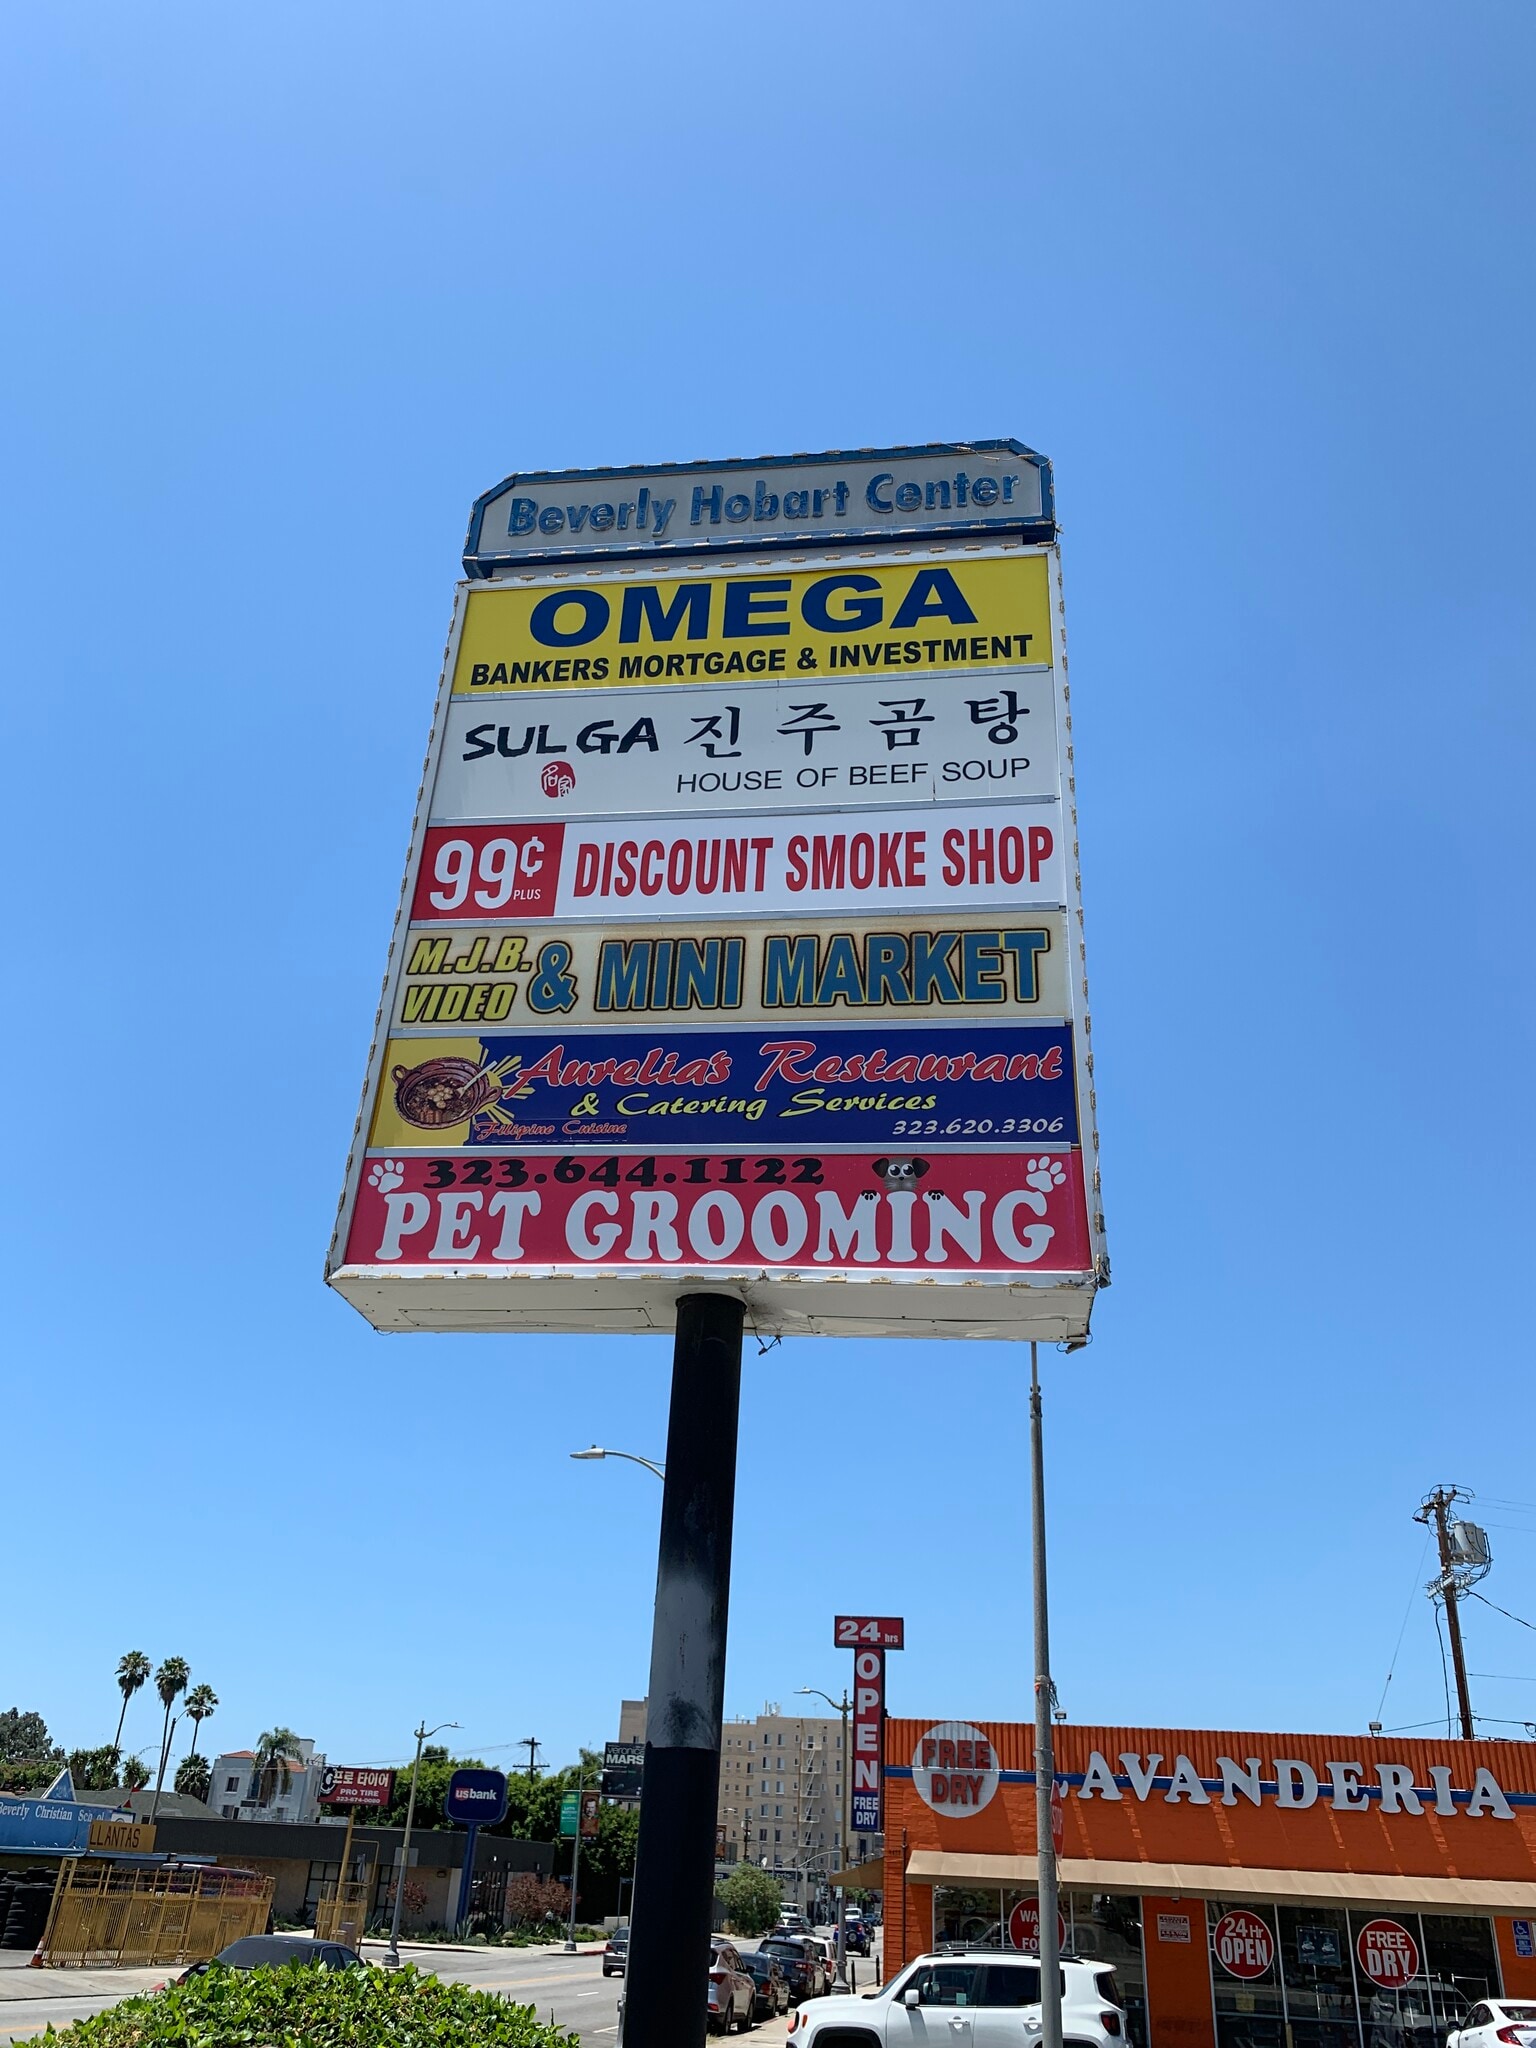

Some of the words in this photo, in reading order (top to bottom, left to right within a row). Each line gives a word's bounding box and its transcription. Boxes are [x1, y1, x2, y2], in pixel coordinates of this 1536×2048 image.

[507, 487, 676, 537] Beverly
[690, 480, 849, 526] Hobart
[866, 471, 1021, 514] Center
[529, 568, 979, 648] OMEGA
[470, 657, 609, 687] BANKERS
[619, 649, 786, 679] MORTGAGE
[798, 648, 817, 669] &
[830, 634, 1033, 668] INVESTMENT
[677, 770, 782, 793] HOUSE
[796, 767, 838, 788] OF
[849, 763, 928, 786] BEEF
[942, 757, 1030, 782] SOUP
[573, 837, 773, 898] DISCOUNT
[785, 831, 926, 891] SMOKE
[942, 826, 1054, 885] SHOP
[513, 889, 541, 901] PLUS
[406, 935, 531, 976] M.J.B.
[527, 940, 577, 1013] &
[595, 937, 744, 1012] MINI
[761, 928, 1050, 1007] MARKET
[401, 982, 514, 1023] VIDEO
[504, 1044, 731, 1099] Aurelia's
[754, 1041, 1064, 1091] Restaurant
[569, 1092, 600, 1116] &
[616, 1091, 768, 1120] Catering
[778, 1088, 937, 1117] Services
[474, 1120, 556, 1140] Filipino
[562, 1120, 627, 1134] Cuisine
[892, 1116, 1064, 1136] 323.620.3306
[422, 1156, 825, 1189] 323.644.1122
[374, 1191, 541, 1261] PET
[564, 1189, 1056, 1264] GROOMING
[838, 1620, 881, 1642] 24
[884, 1634, 899, 1643] hrs
[855, 1652, 880, 1788] OPEN
[606, 1754, 645, 1765] MARS
[922, 1738, 991, 1769] FREE
[340, 1788, 358, 1796] PRO
[360, 1789, 379, 1797] TIRE
[357, 1771, 390, 1787] 타이어
[931, 1773, 984, 1805] DRY
[35, 1805, 73, 1821] Christian
[853, 1797, 878, 1810] FREE
[856, 1812, 876, 1825] DRY
[89, 1824, 141, 1849] LLANTAS
[1020, 1910, 1039, 1923] WA
[1224, 1917, 1248, 1937] 24
[1249, 1924, 1264, 1938] Hr
[1022, 1938, 1040, 1950] FO
[1220, 1937, 1268, 1966] OPEN
[1366, 1930, 1408, 1949] FREE
[1367, 1949, 1411, 1977] DRY
